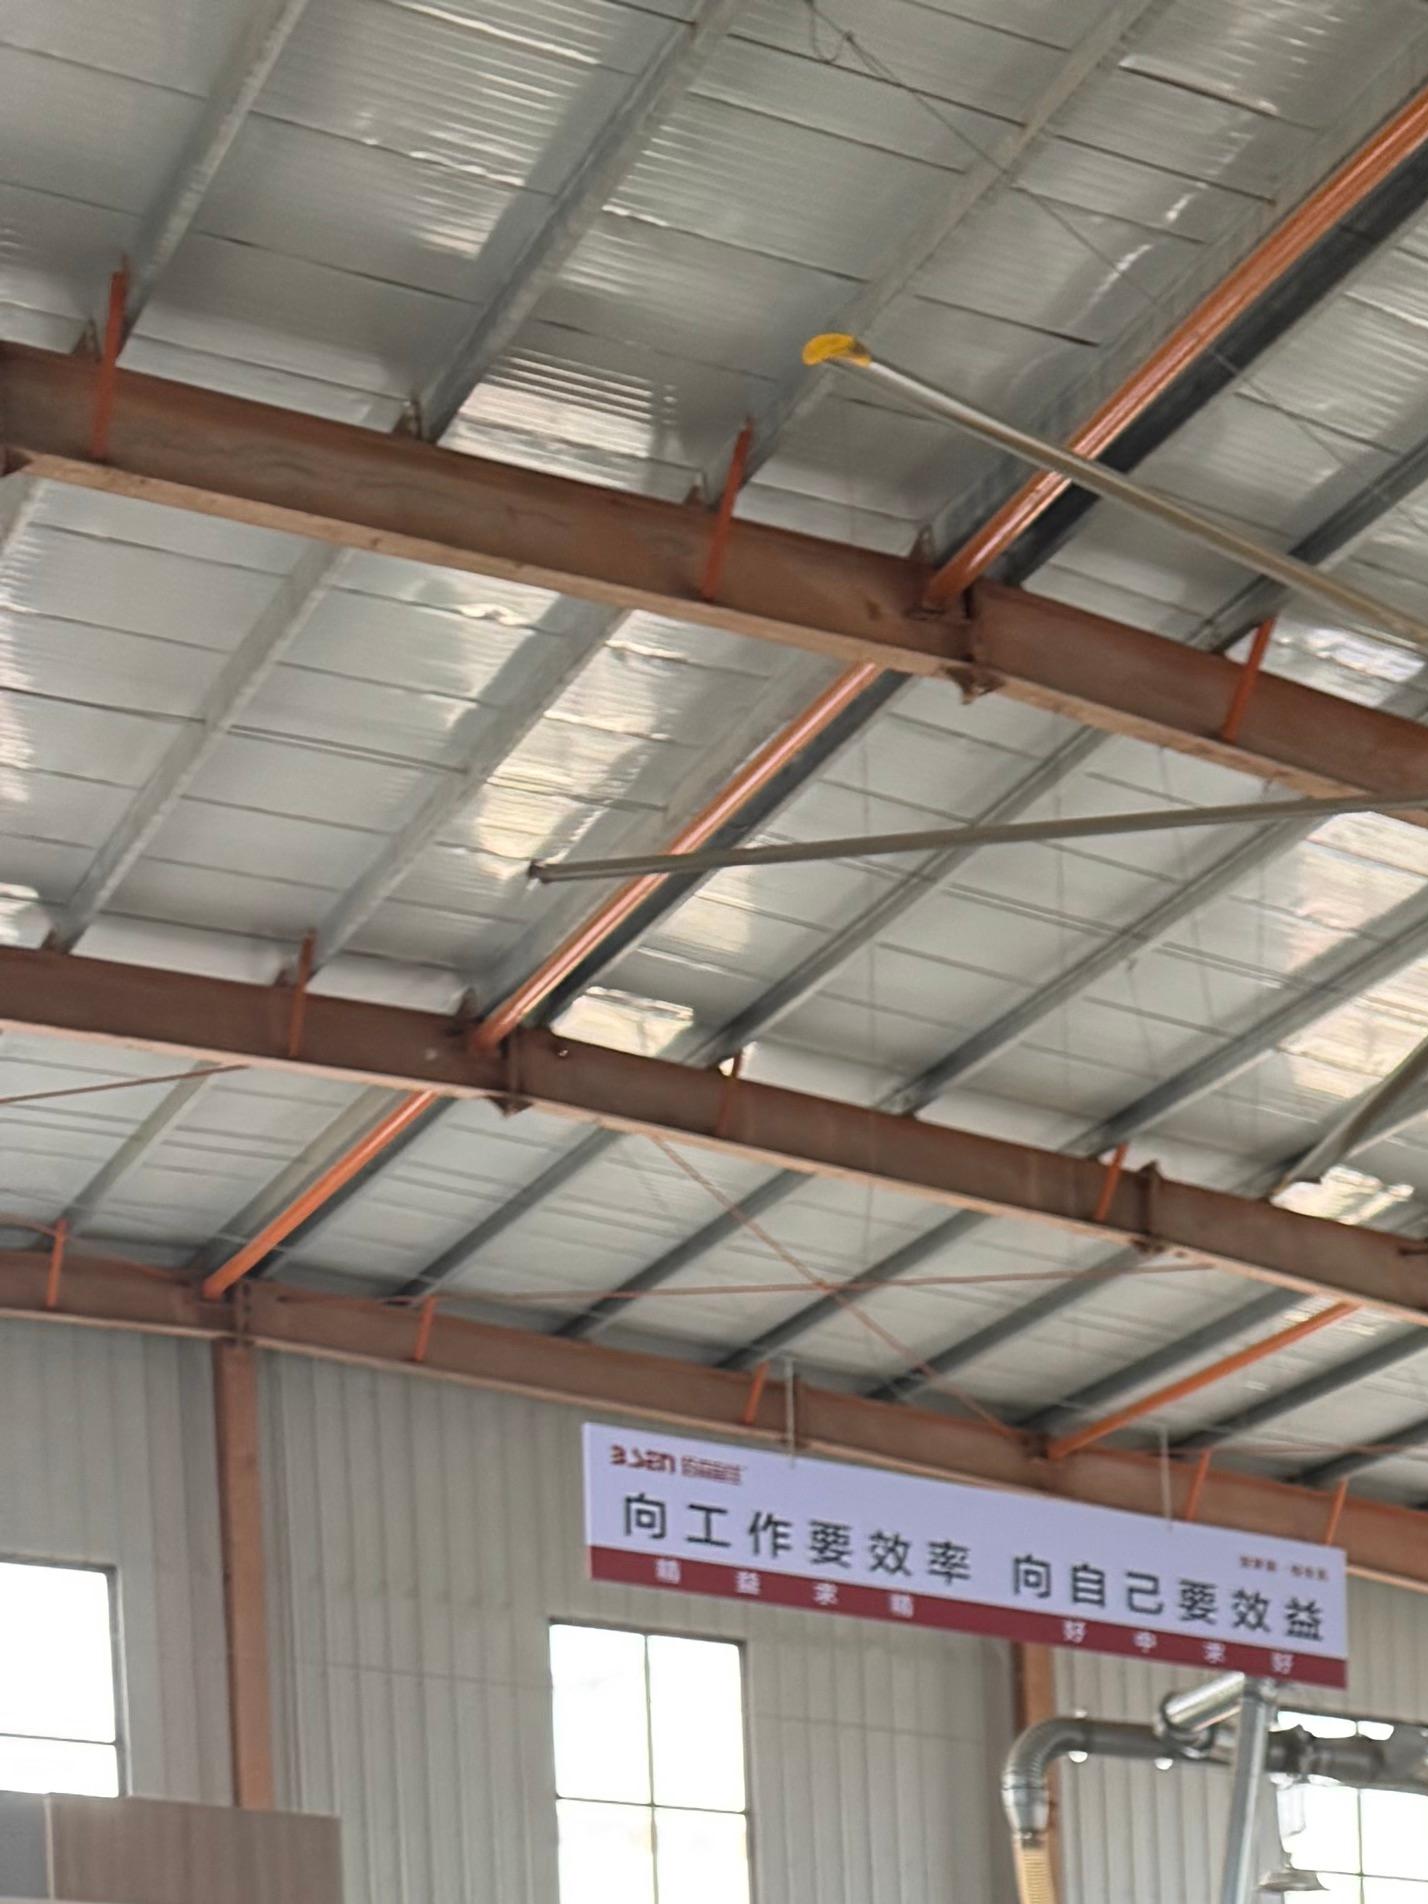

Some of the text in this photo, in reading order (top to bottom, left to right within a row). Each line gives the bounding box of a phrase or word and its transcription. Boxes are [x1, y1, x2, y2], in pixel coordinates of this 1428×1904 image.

[622, 1492, 1326, 1643] 向工作要效率 向自己要效益
